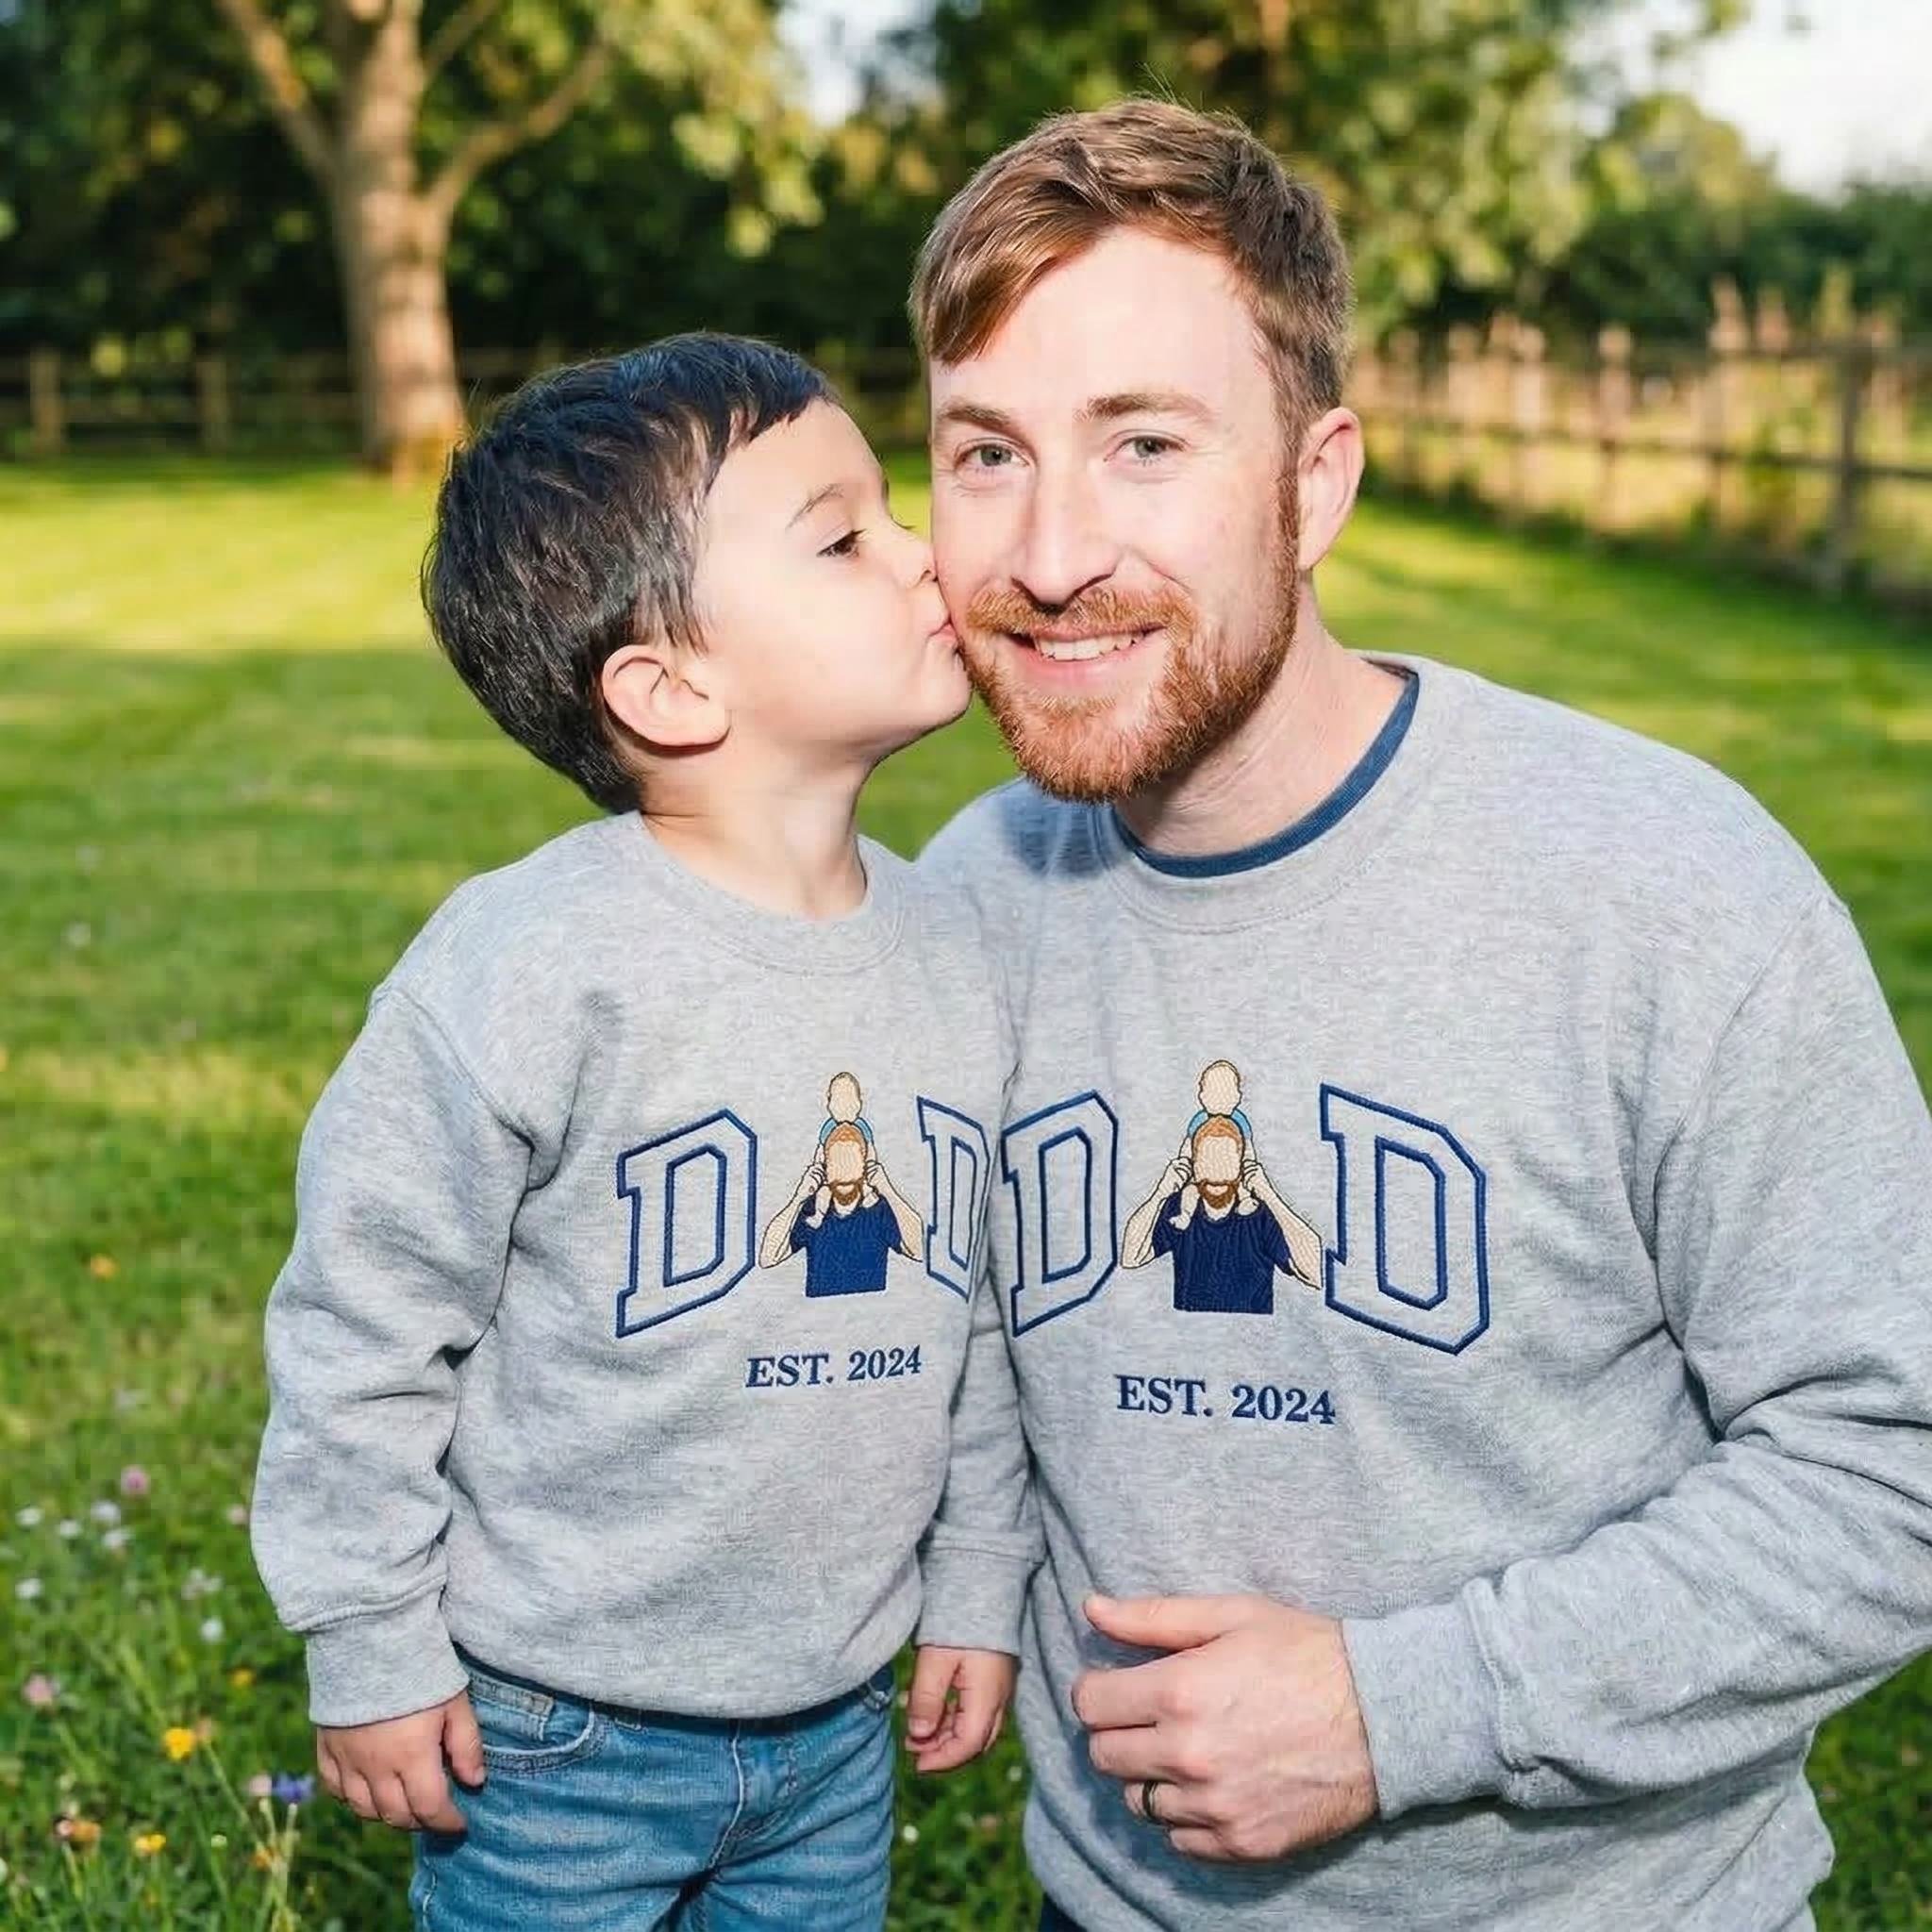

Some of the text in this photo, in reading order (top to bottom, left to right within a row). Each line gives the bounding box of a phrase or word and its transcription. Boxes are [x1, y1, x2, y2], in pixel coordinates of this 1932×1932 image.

[745, 1344, 923, 1388] EST. 2024
[1115, 1374, 1337, 1425] EST. 2024
